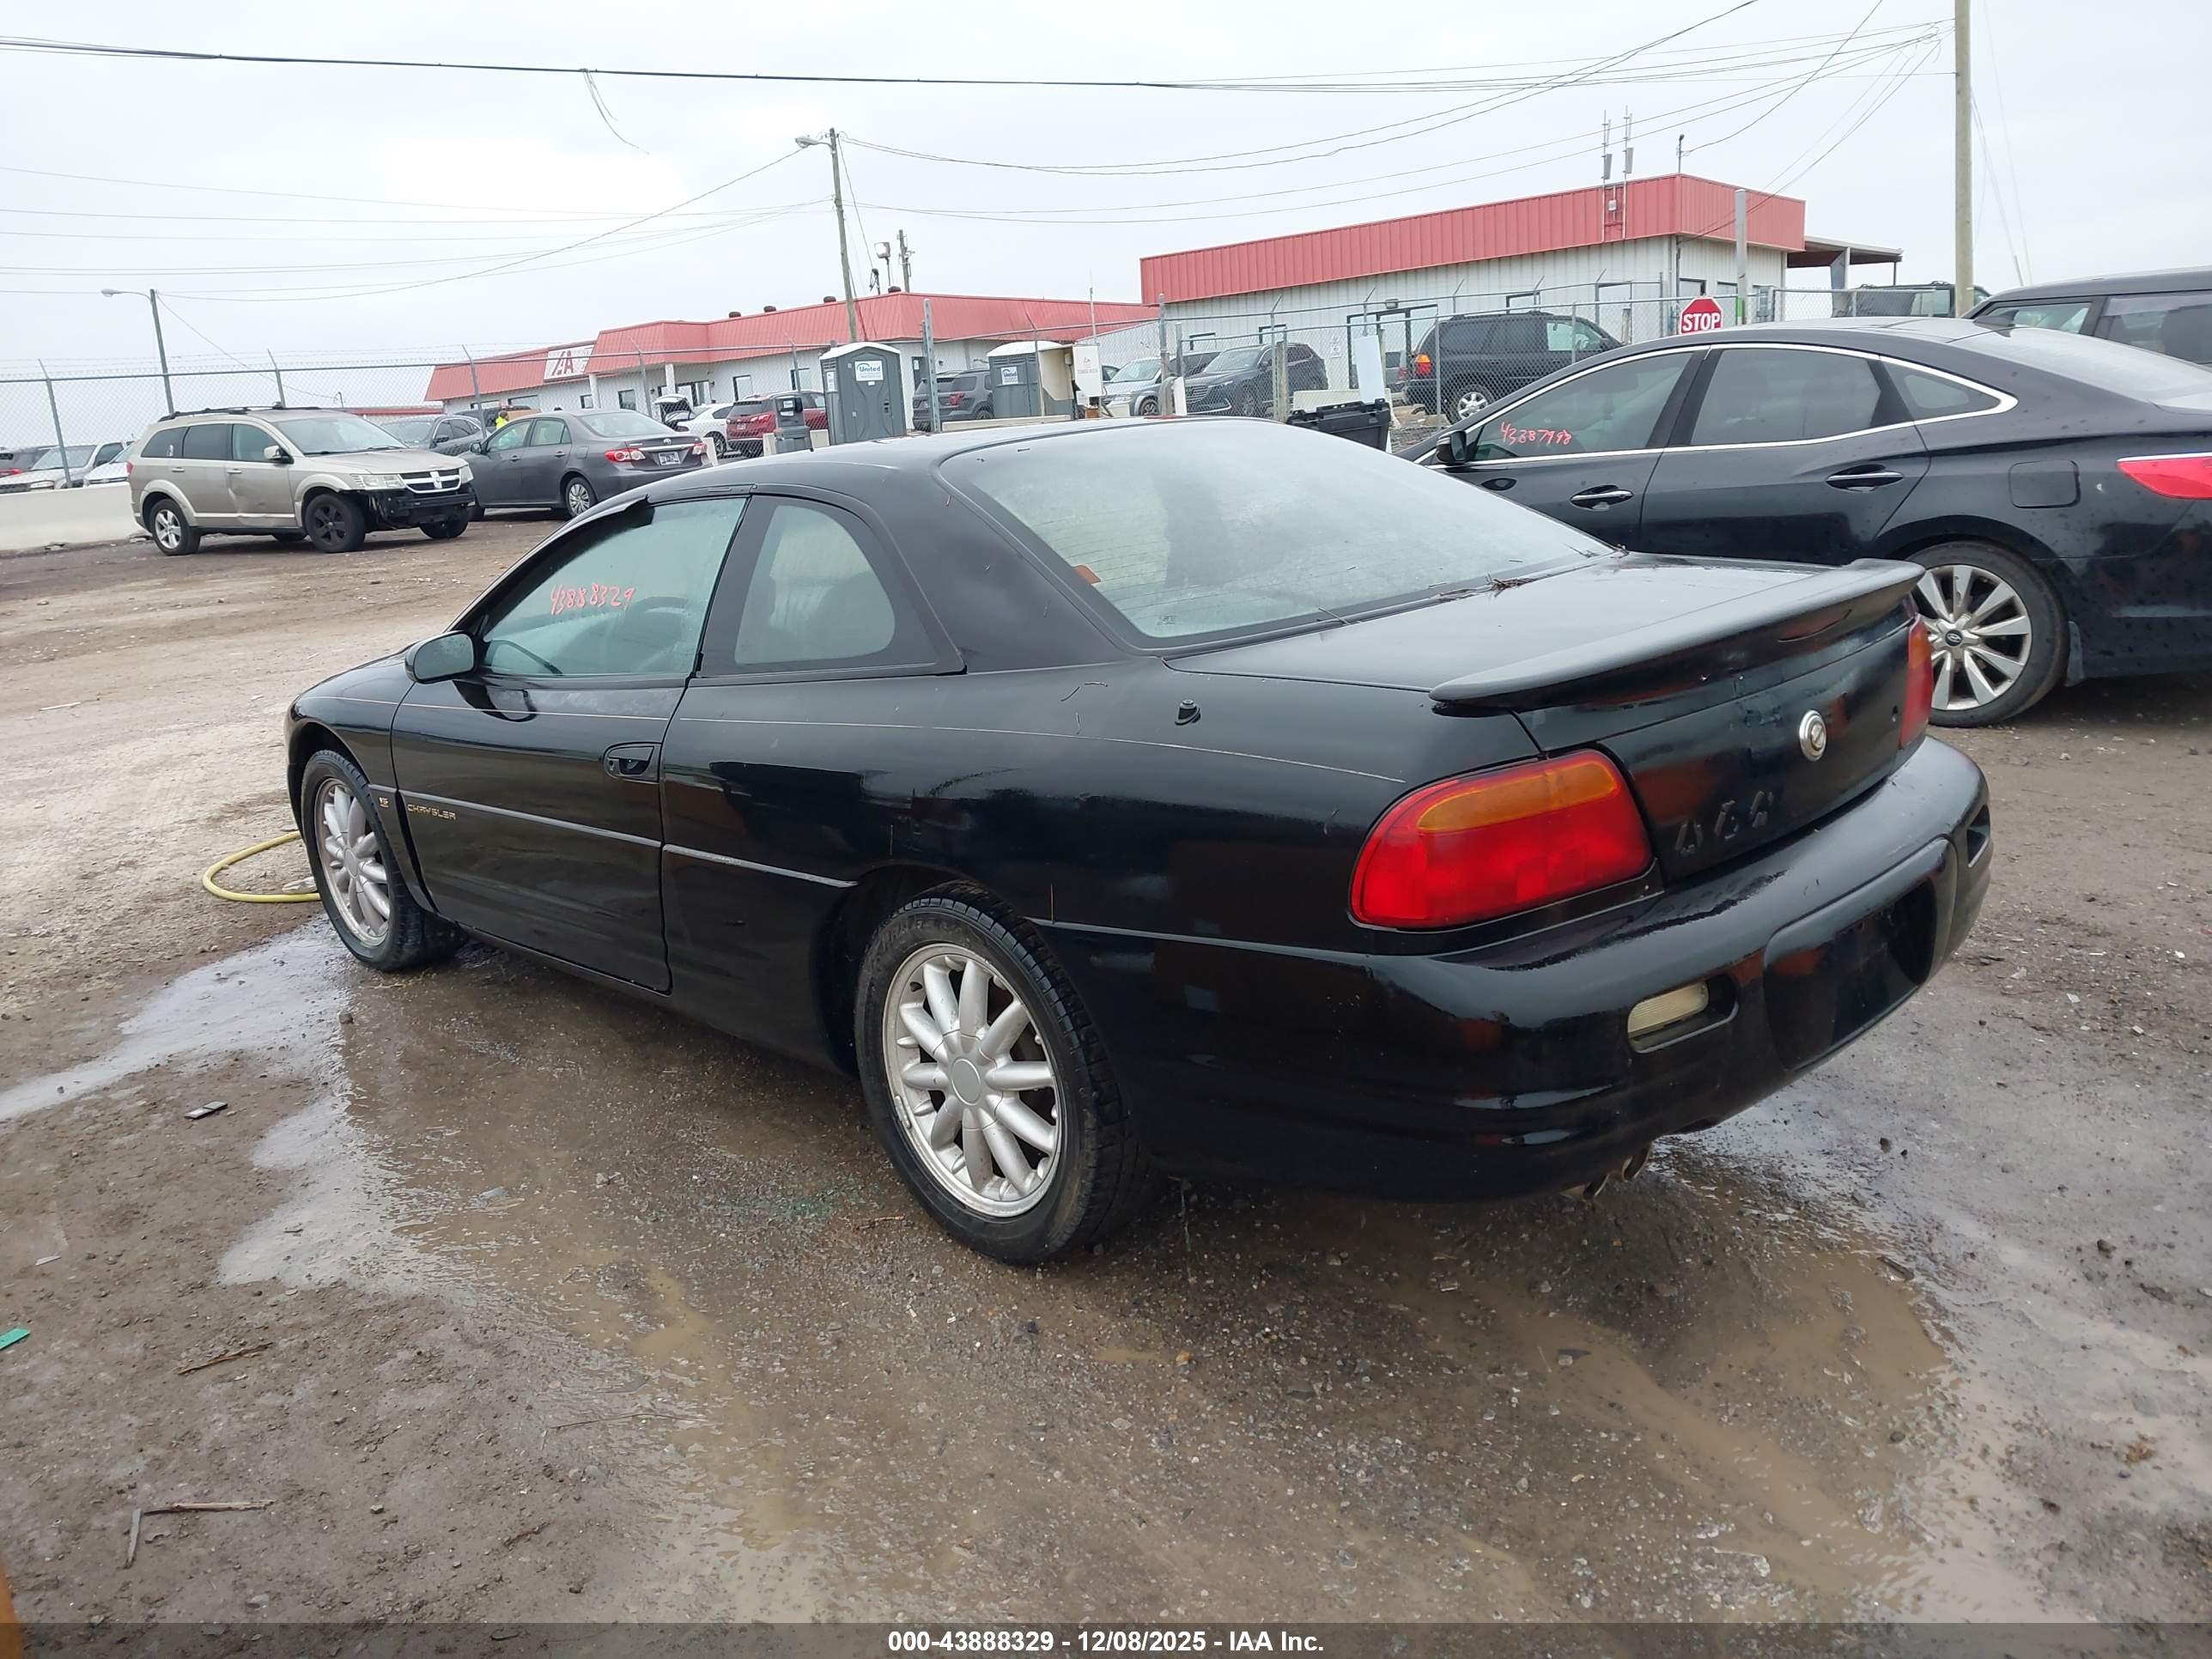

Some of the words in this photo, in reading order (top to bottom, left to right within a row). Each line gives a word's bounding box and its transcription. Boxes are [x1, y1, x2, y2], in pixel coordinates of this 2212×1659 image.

[1683, 313, 1720, 331] STOP
[550, 583, 635, 615] 43888329
[407, 804, 457, 820] CHRYSLER
